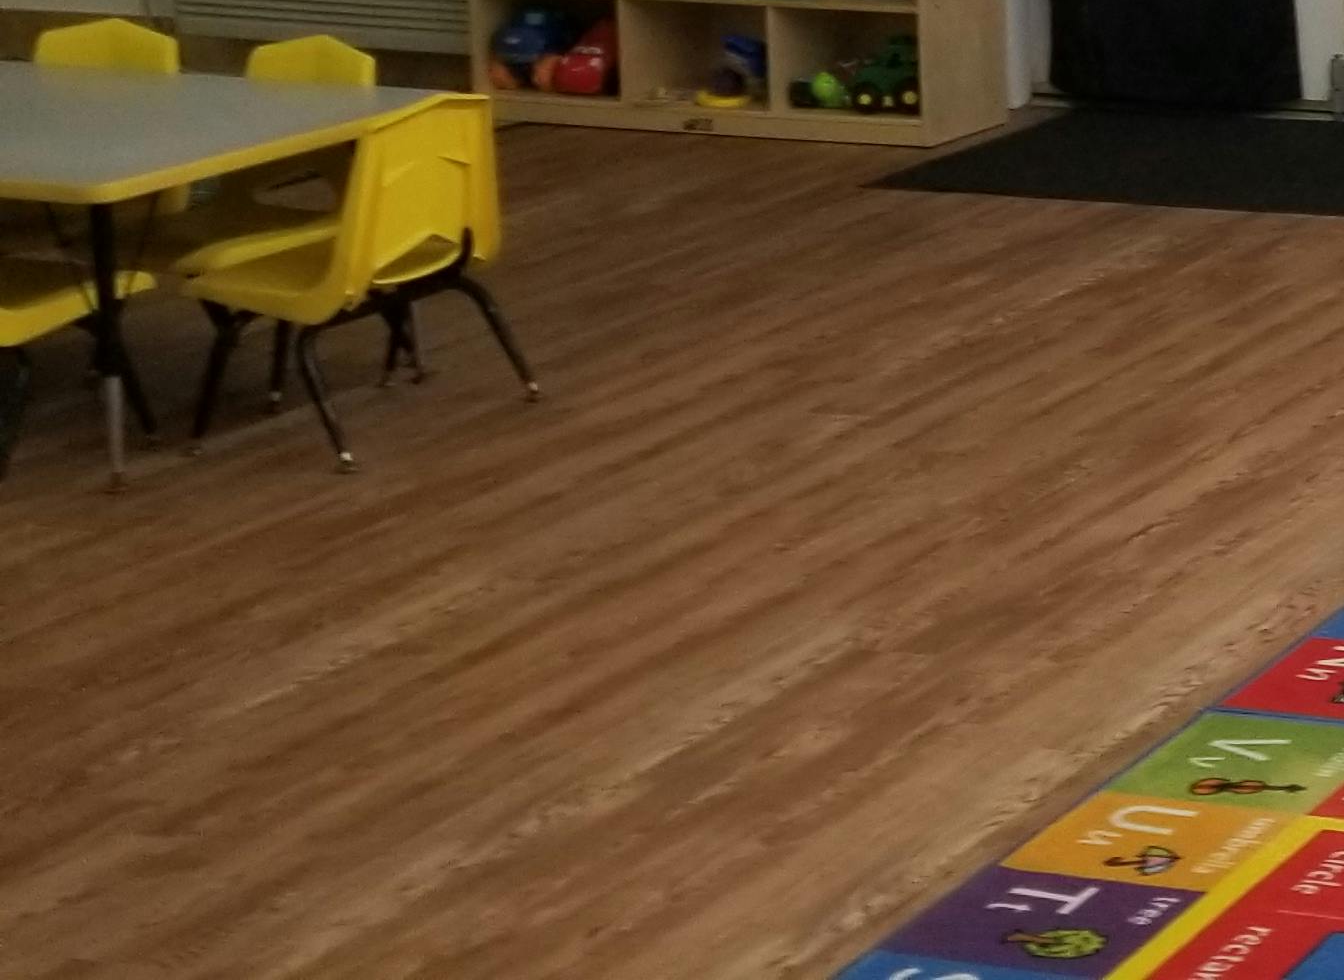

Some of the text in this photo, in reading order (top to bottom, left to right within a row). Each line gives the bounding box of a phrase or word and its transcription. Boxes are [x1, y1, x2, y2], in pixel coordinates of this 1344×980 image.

[1187, 737, 1293, 769] Vv
[1076, 804, 1200, 846] Uu
[1190, 818, 1277, 875] umbrella
[985, 885, 1100, 915] Tt
[1126, 896, 1182, 926] tree
